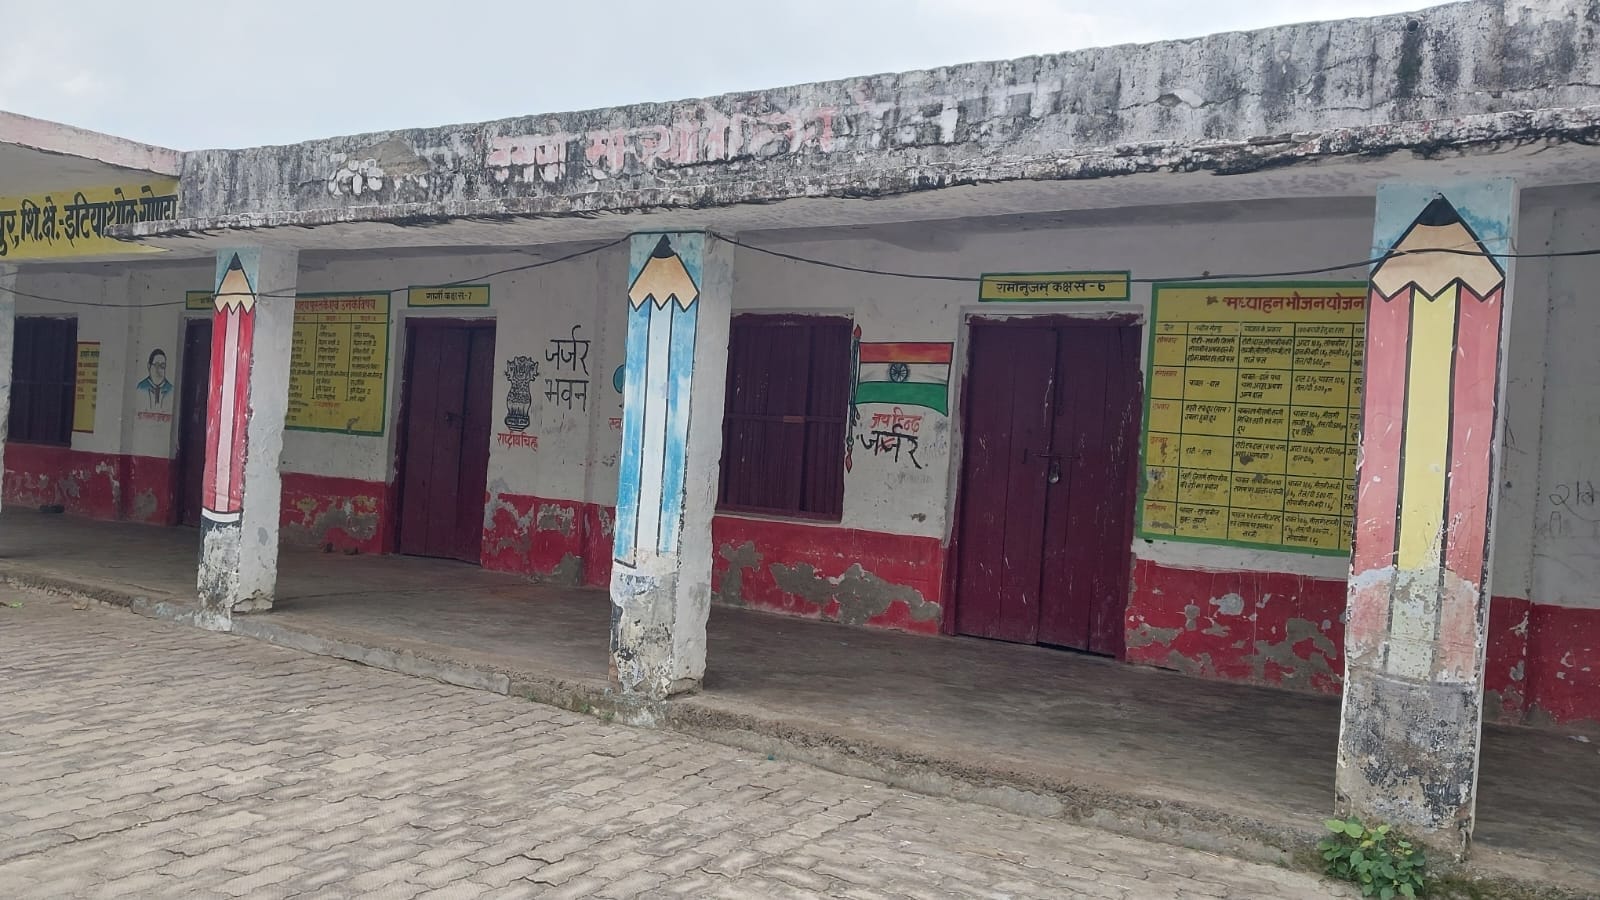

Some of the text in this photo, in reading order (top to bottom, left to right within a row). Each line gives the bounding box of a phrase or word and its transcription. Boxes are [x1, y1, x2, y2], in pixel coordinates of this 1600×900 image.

[1325, 292, 1367, 313] योजन
[546, 325, 591, 376] जर्जर
[545, 378, 589, 412] भवन
[860, 424, 923, 470] जर्जर
